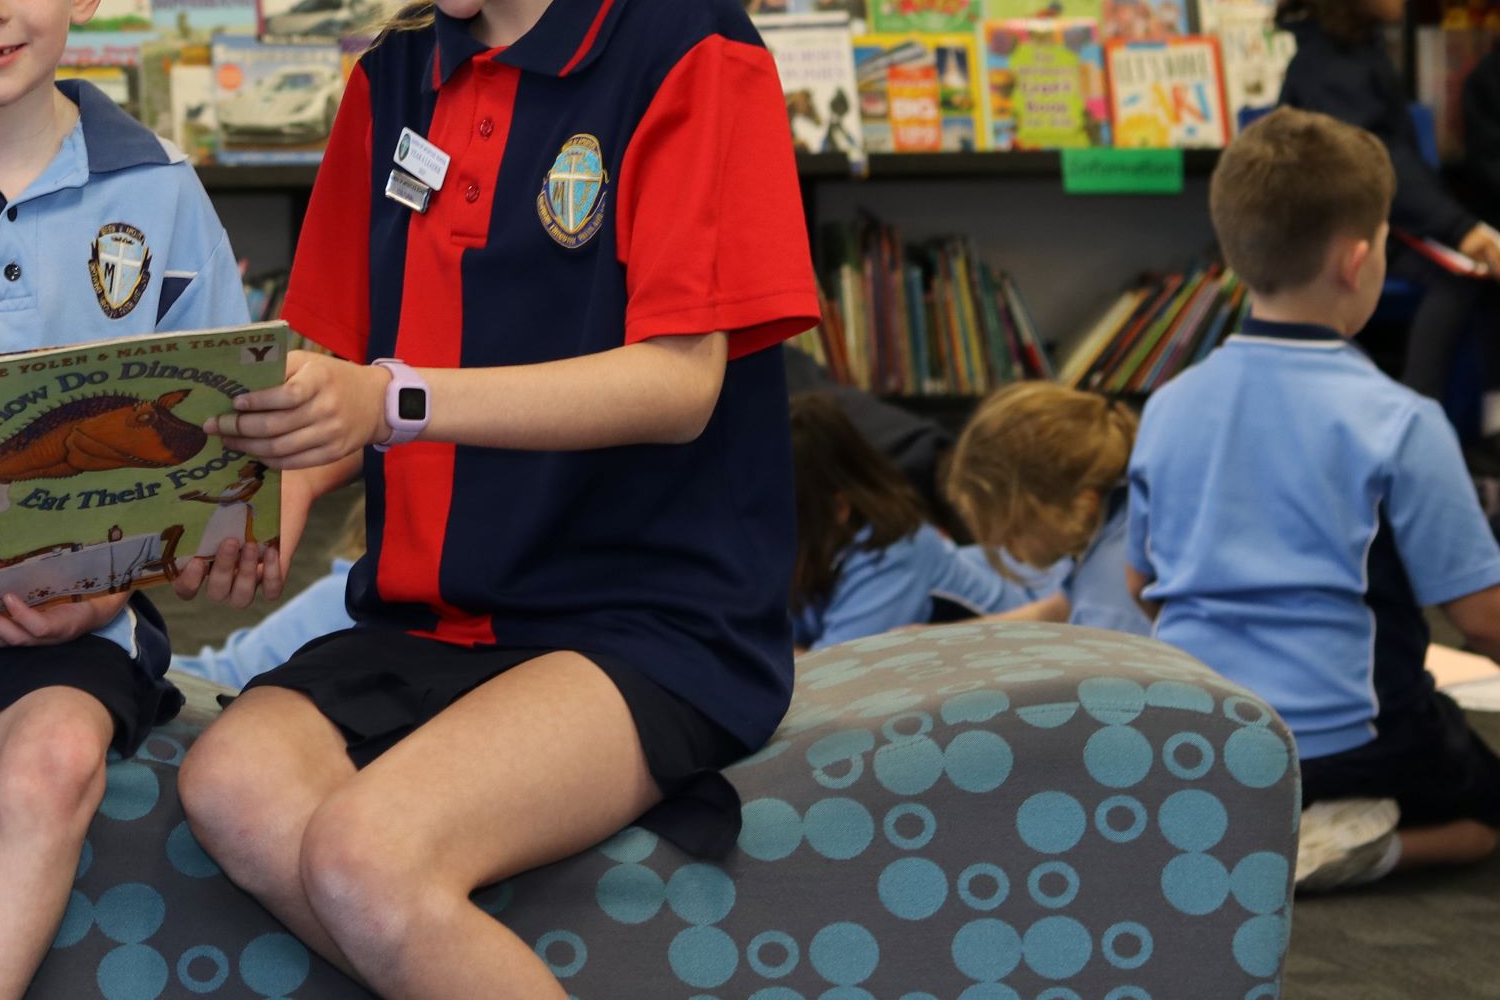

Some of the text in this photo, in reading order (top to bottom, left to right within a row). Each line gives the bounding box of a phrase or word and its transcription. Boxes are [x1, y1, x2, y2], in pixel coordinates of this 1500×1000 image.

[18, 352, 89, 376] YOLEN
[98, 350, 110, 363] &
[116, 341, 181, 360] MARK
[188, 332, 277, 351] TEAGUE
[246, 344, 275, 362] Y
[54, 366, 110, 394] Do
[116, 360, 251, 401] Dinosau
[16, 486, 72, 513] Eat
[75, 480, 162, 511] Their
